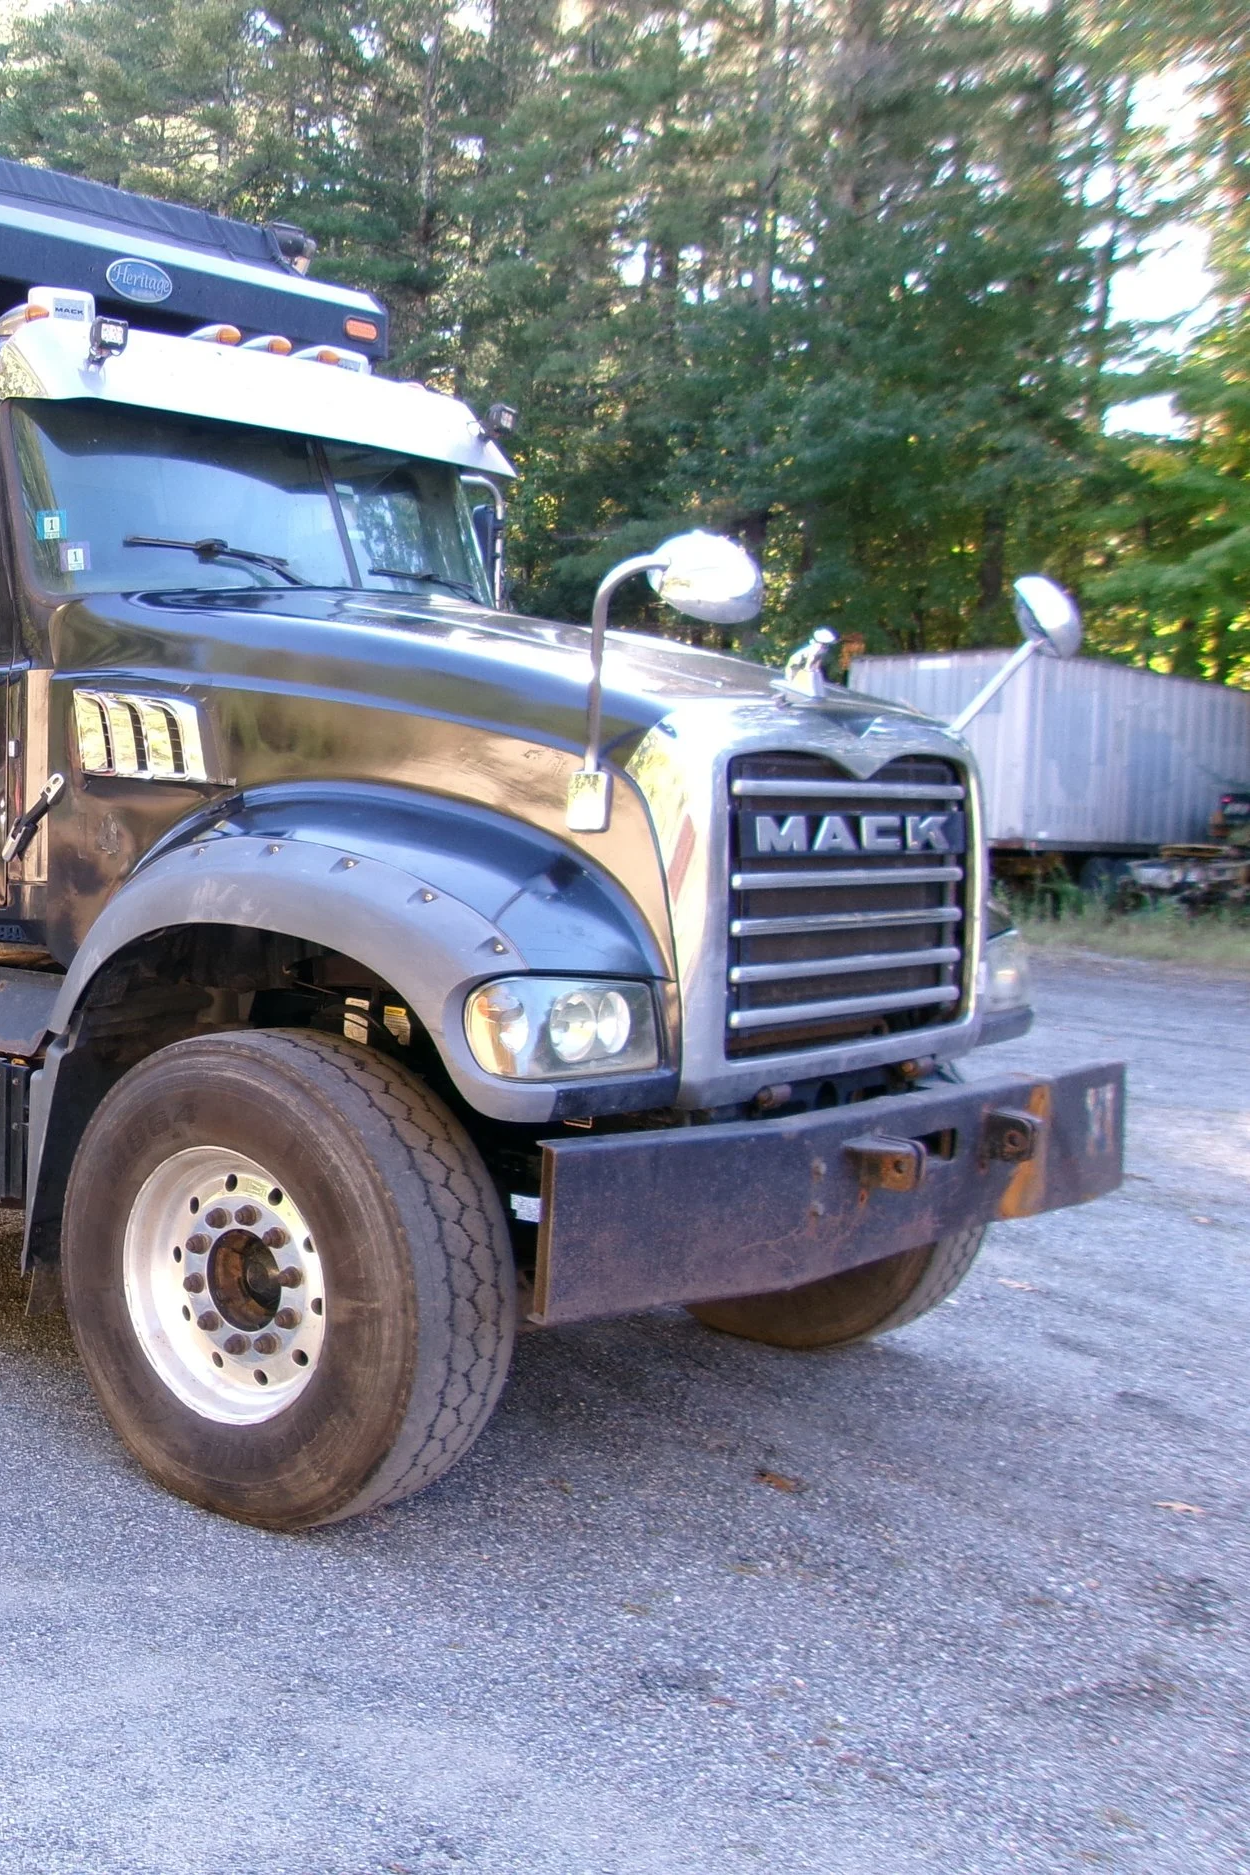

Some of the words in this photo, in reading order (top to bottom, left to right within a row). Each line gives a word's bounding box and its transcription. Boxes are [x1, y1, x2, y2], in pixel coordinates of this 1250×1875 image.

[111, 264, 170, 297] Heritage
[54, 306, 84, 315] MACK
[755, 815, 950, 851] MACK
